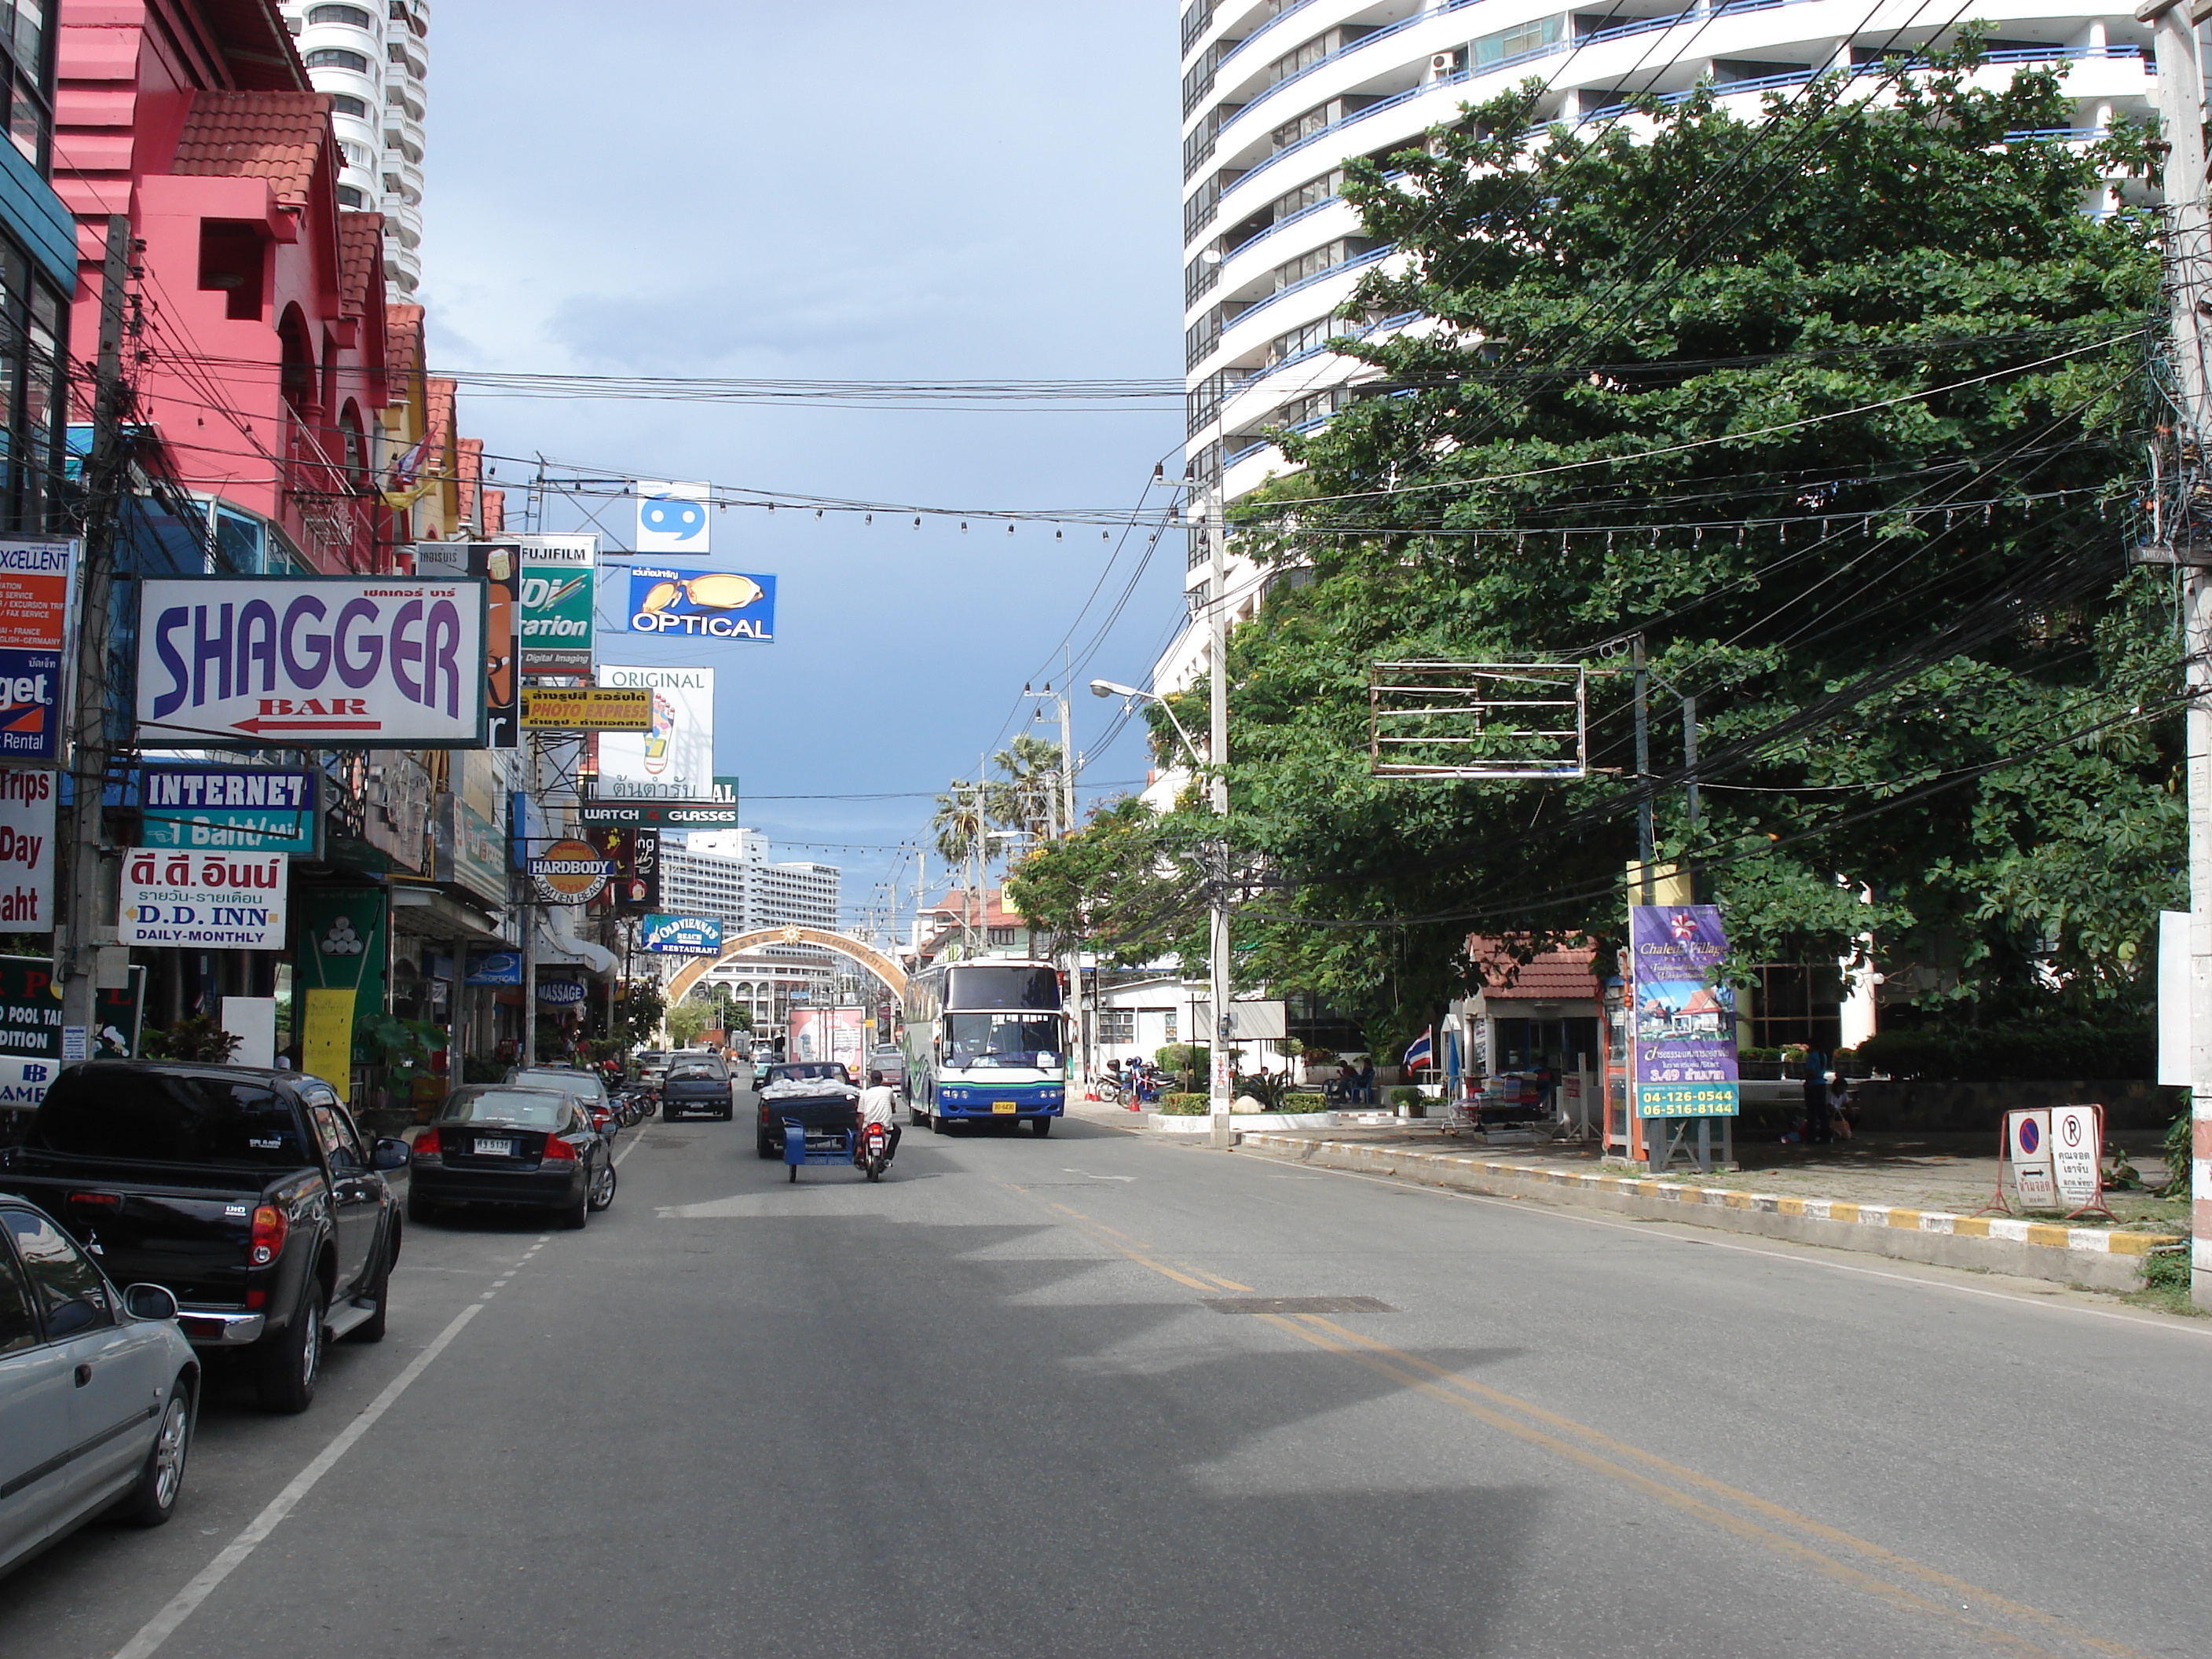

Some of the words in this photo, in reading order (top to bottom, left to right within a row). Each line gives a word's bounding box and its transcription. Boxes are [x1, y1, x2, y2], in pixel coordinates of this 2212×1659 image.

[522, 548, 586, 560] FUJIFILM
[430, 588, 456, 597] บาร์
[21, 610, 49, 619] SERVICE
[13, 628, 42, 636] FRANCE
[631, 612, 773, 639] OPTICAL
[153, 595, 460, 720] SHAGGER
[526, 654, 553, 665] Digital
[555, 654, 589, 665] Imaging
[612, 672, 705, 688] ORIGINAL
[256, 699, 370, 716] BAR
[531, 703, 582, 717] PHOTO
[584, 704, 649, 719] EXPRESS
[4, 733, 44, 750] Rental
[148, 775, 307, 806] INTERNET
[613, 773, 696, 799] ต้นตำรับ
[584, 809, 639, 820] WATCH
[668, 811, 736, 822] GLASSES
[0, 826, 42, 870] Day
[533, 861, 611, 875] HARDBODY
[536, 875, 574, 903] JOMTIEN
[577, 876, 606, 903] BEACH
[557, 881, 585, 892] GYM
[211, 906, 269, 926] INN
[136, 929, 266, 943] DAILY-MONTHLY
[677, 932, 702, 941] BEACH
[662, 944, 719, 954] RESTAURANT
[866, 954, 884, 969] CITY
[537, 983, 581, 1002] MASSAGE
[9, 1006, 39, 1024] POOL
[1650, 1069, 1680, 1082] 3.49
[1643, 1090, 1733, 1103] 04-126-0544
[1643, 1104, 1733, 1115] 06-516-8144
[2058, 1152, 2090, 1163] คุณจอด
[2019, 1177, 2051, 1192] ห้ามจอด
